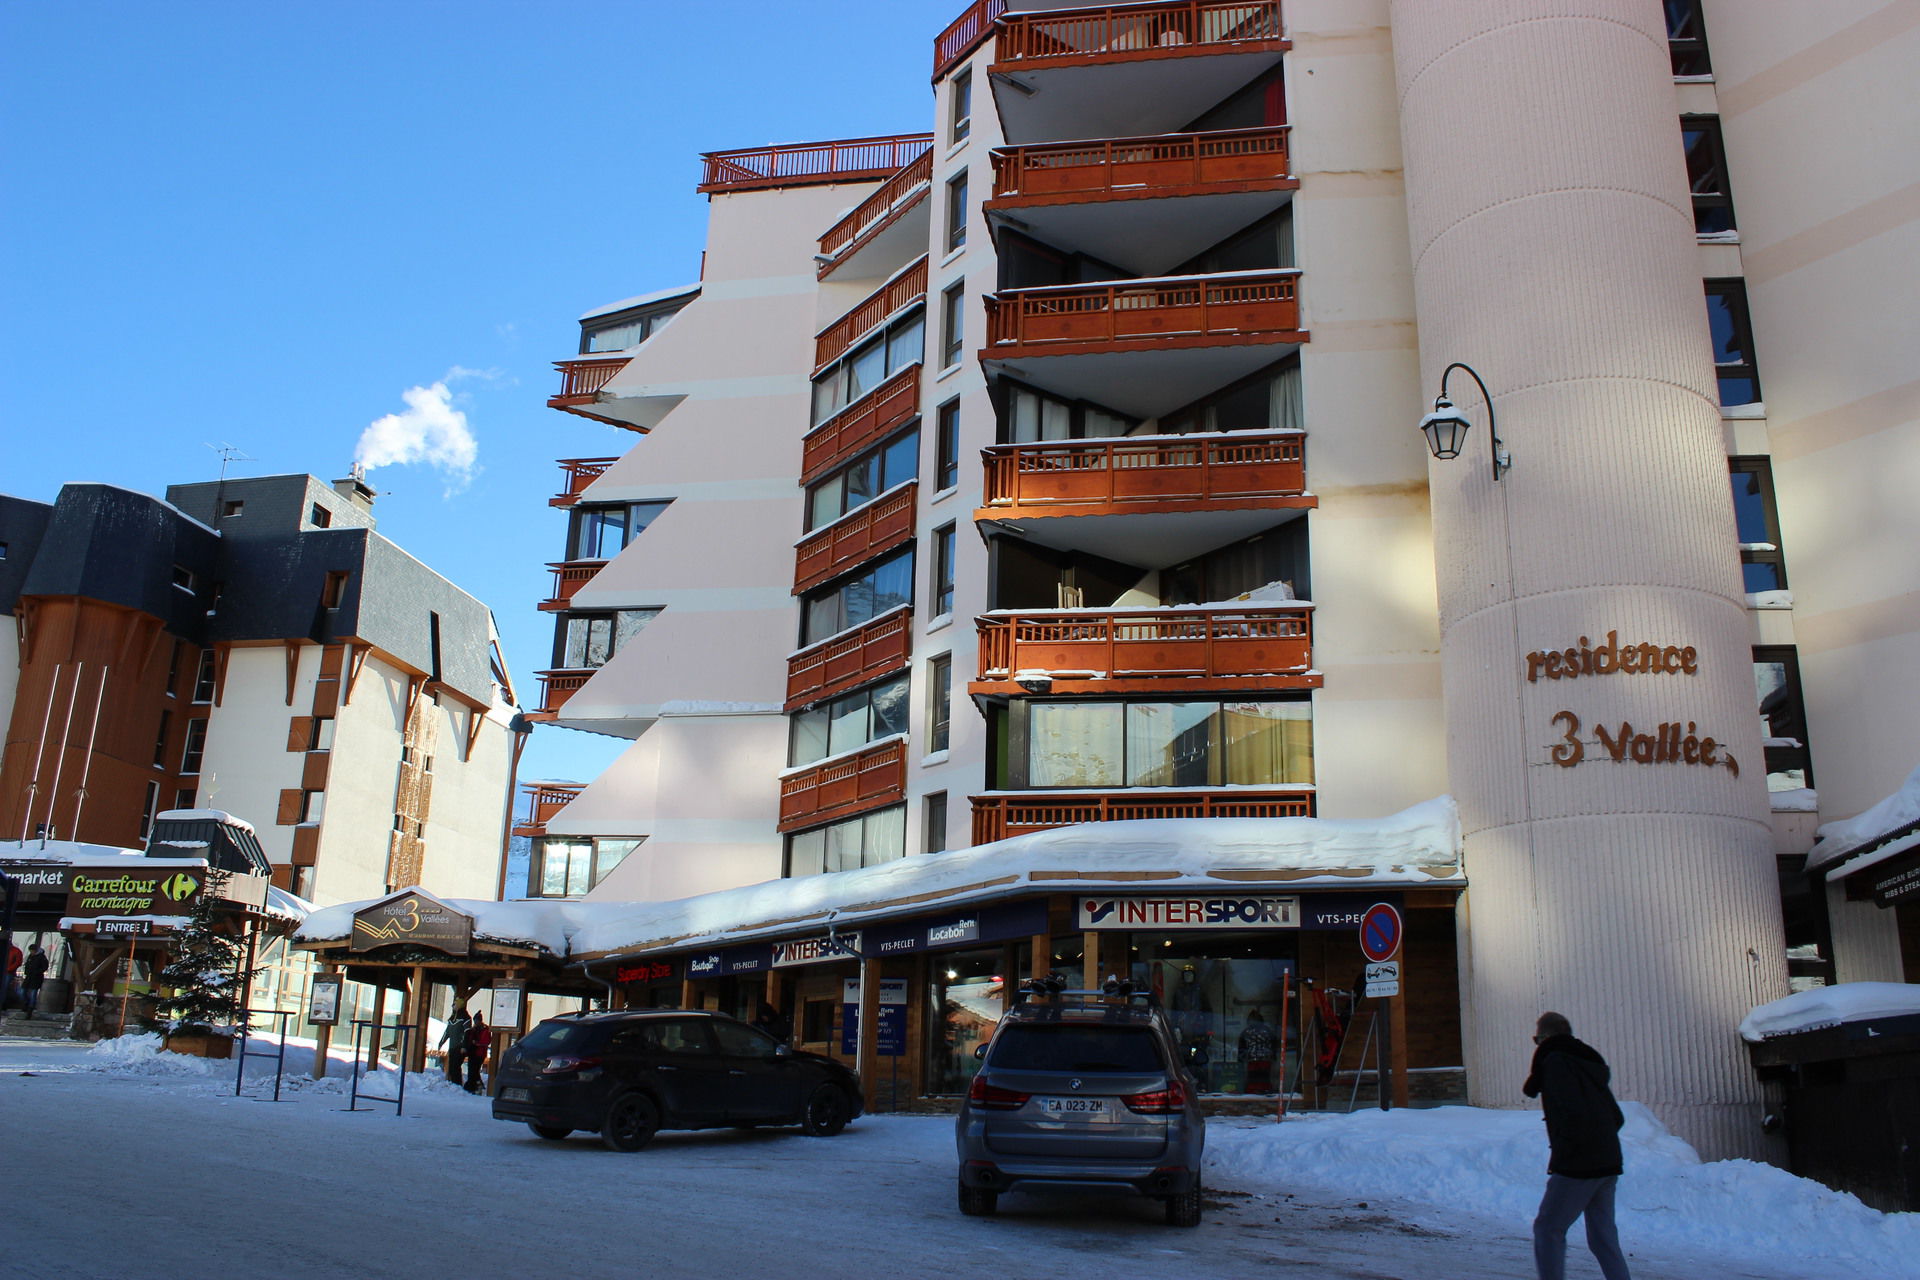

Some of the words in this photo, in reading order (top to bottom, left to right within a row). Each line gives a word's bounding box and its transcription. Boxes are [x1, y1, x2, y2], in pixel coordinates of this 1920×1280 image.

[1526, 629, 1697, 682] residence
[1551, 710, 1584, 767] 3
[72, 875, 157, 893] Carrefour
[80, 896, 152, 915] montagne
[1119, 900, 1293, 923] INTERSPORT
[383, 905, 407, 916] Hôtel
[401, 899, 420, 932] 3
[420, 914, 450, 924] Vallées
[959, 920, 975, 928] Rent
[930, 927, 965, 940] Location
[691, 960, 714, 972] Boutique
